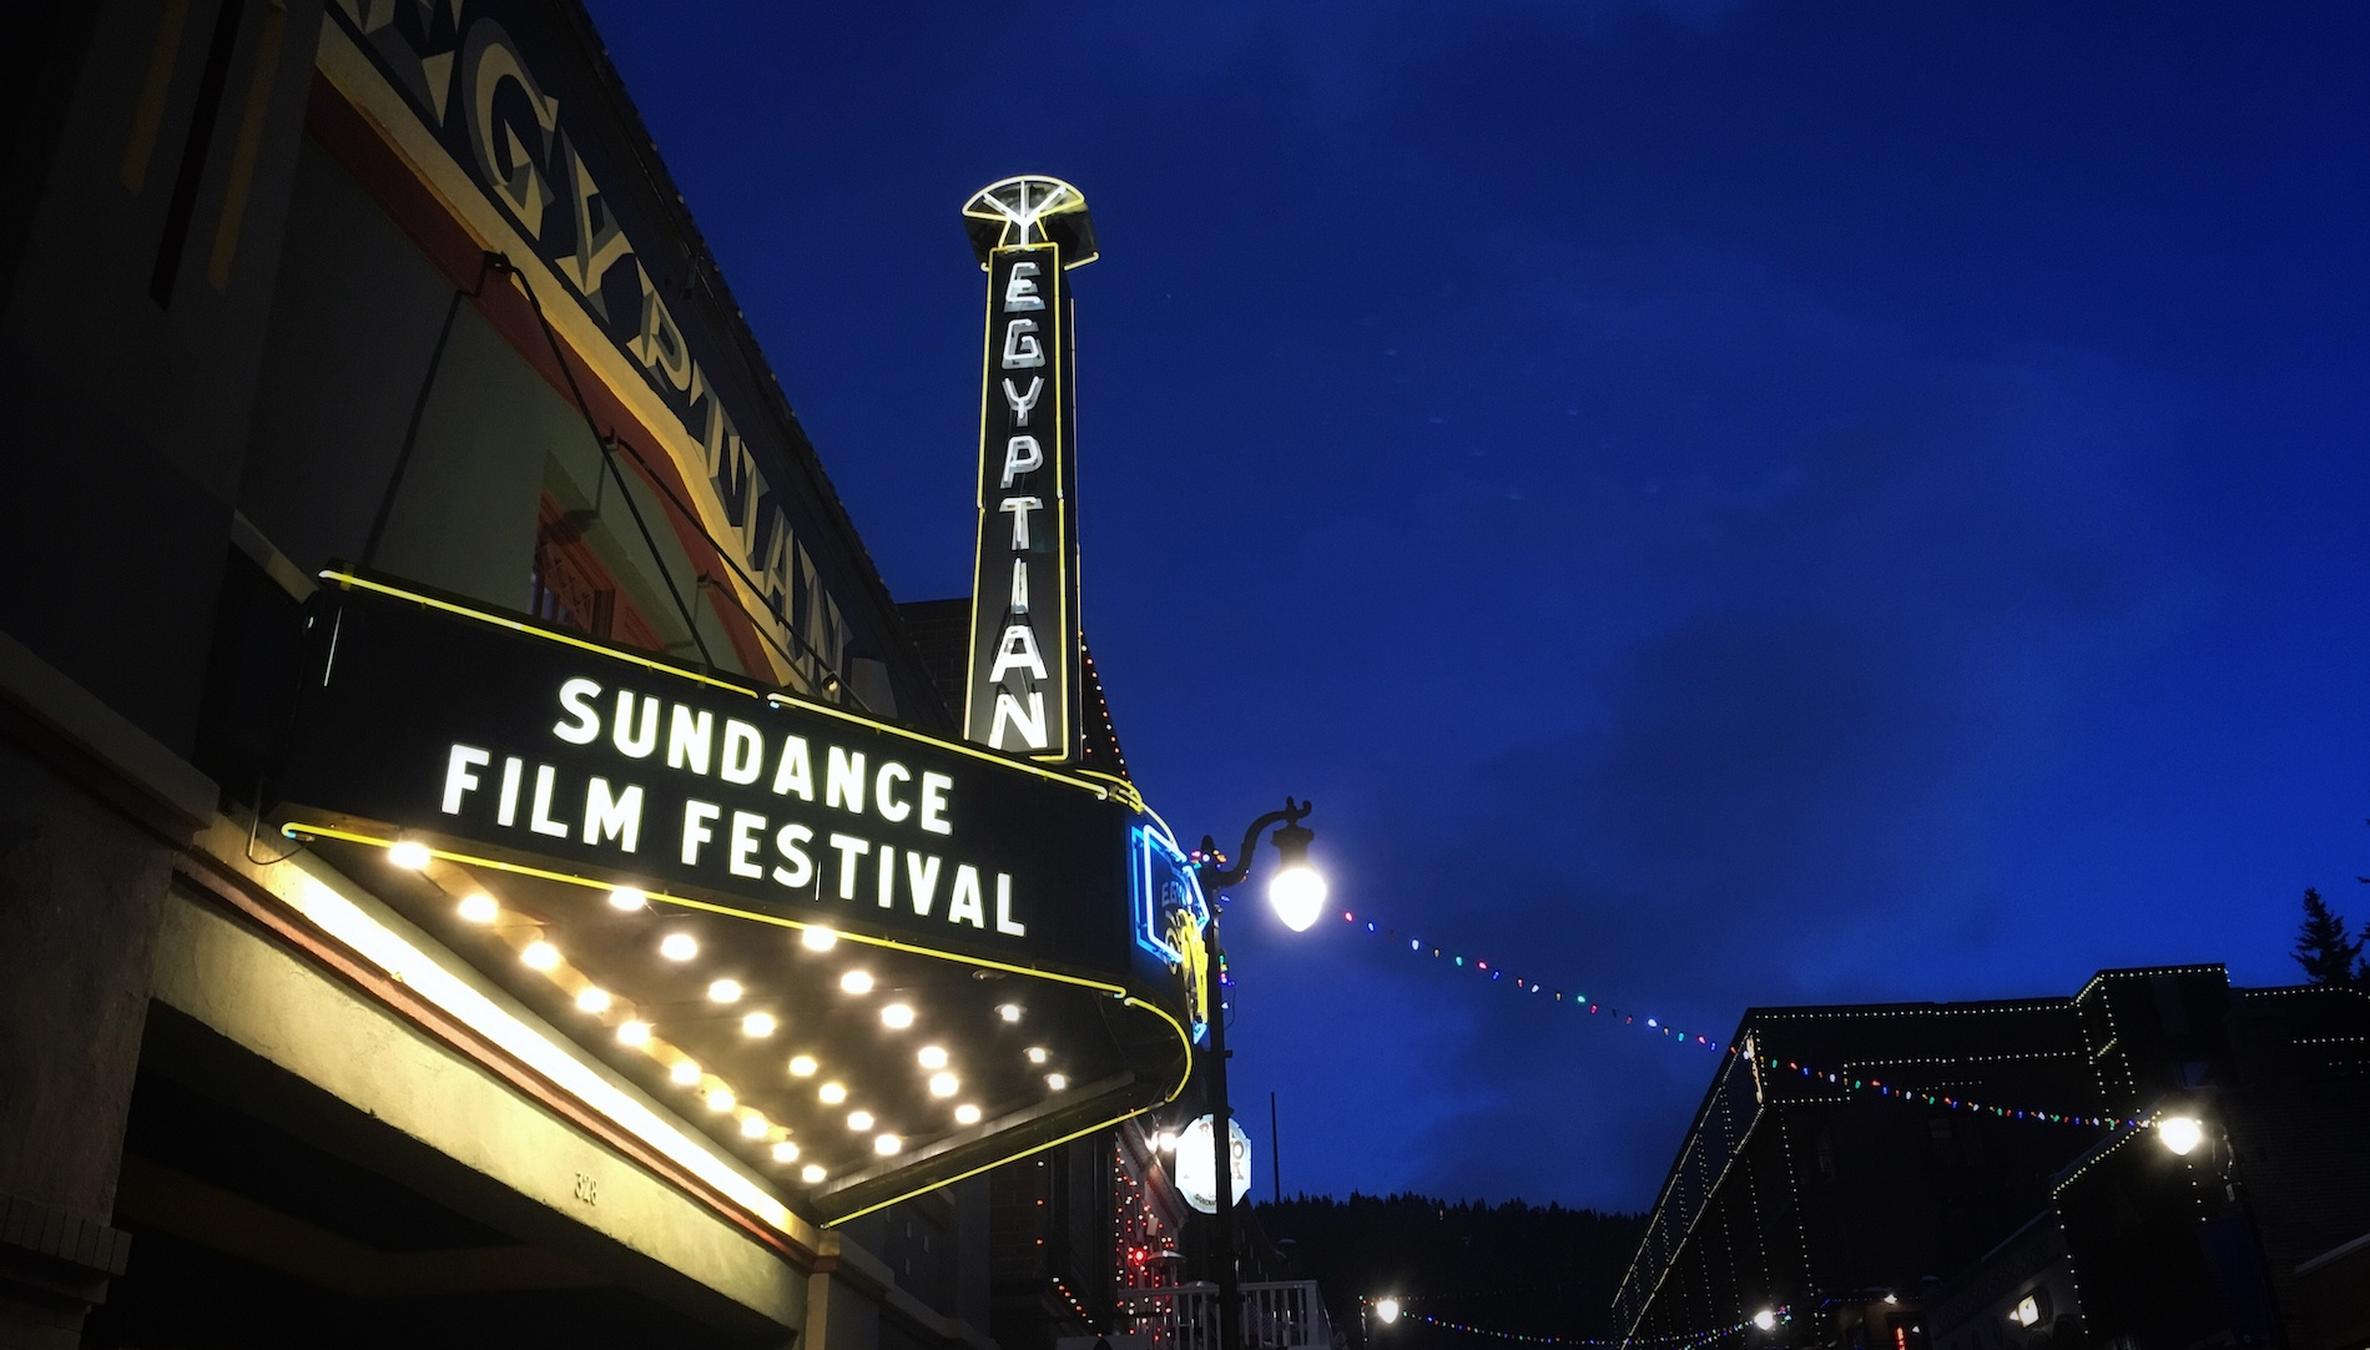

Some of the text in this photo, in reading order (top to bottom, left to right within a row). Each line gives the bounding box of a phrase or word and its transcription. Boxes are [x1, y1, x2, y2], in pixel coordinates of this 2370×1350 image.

[988, 261, 1048, 750] EGYPTIAN
[440, 744, 1026, 937] FILM FESTIVAL
[553, 677, 953, 836] SUNDANCE
[574, 1170, 599, 1206] 328
